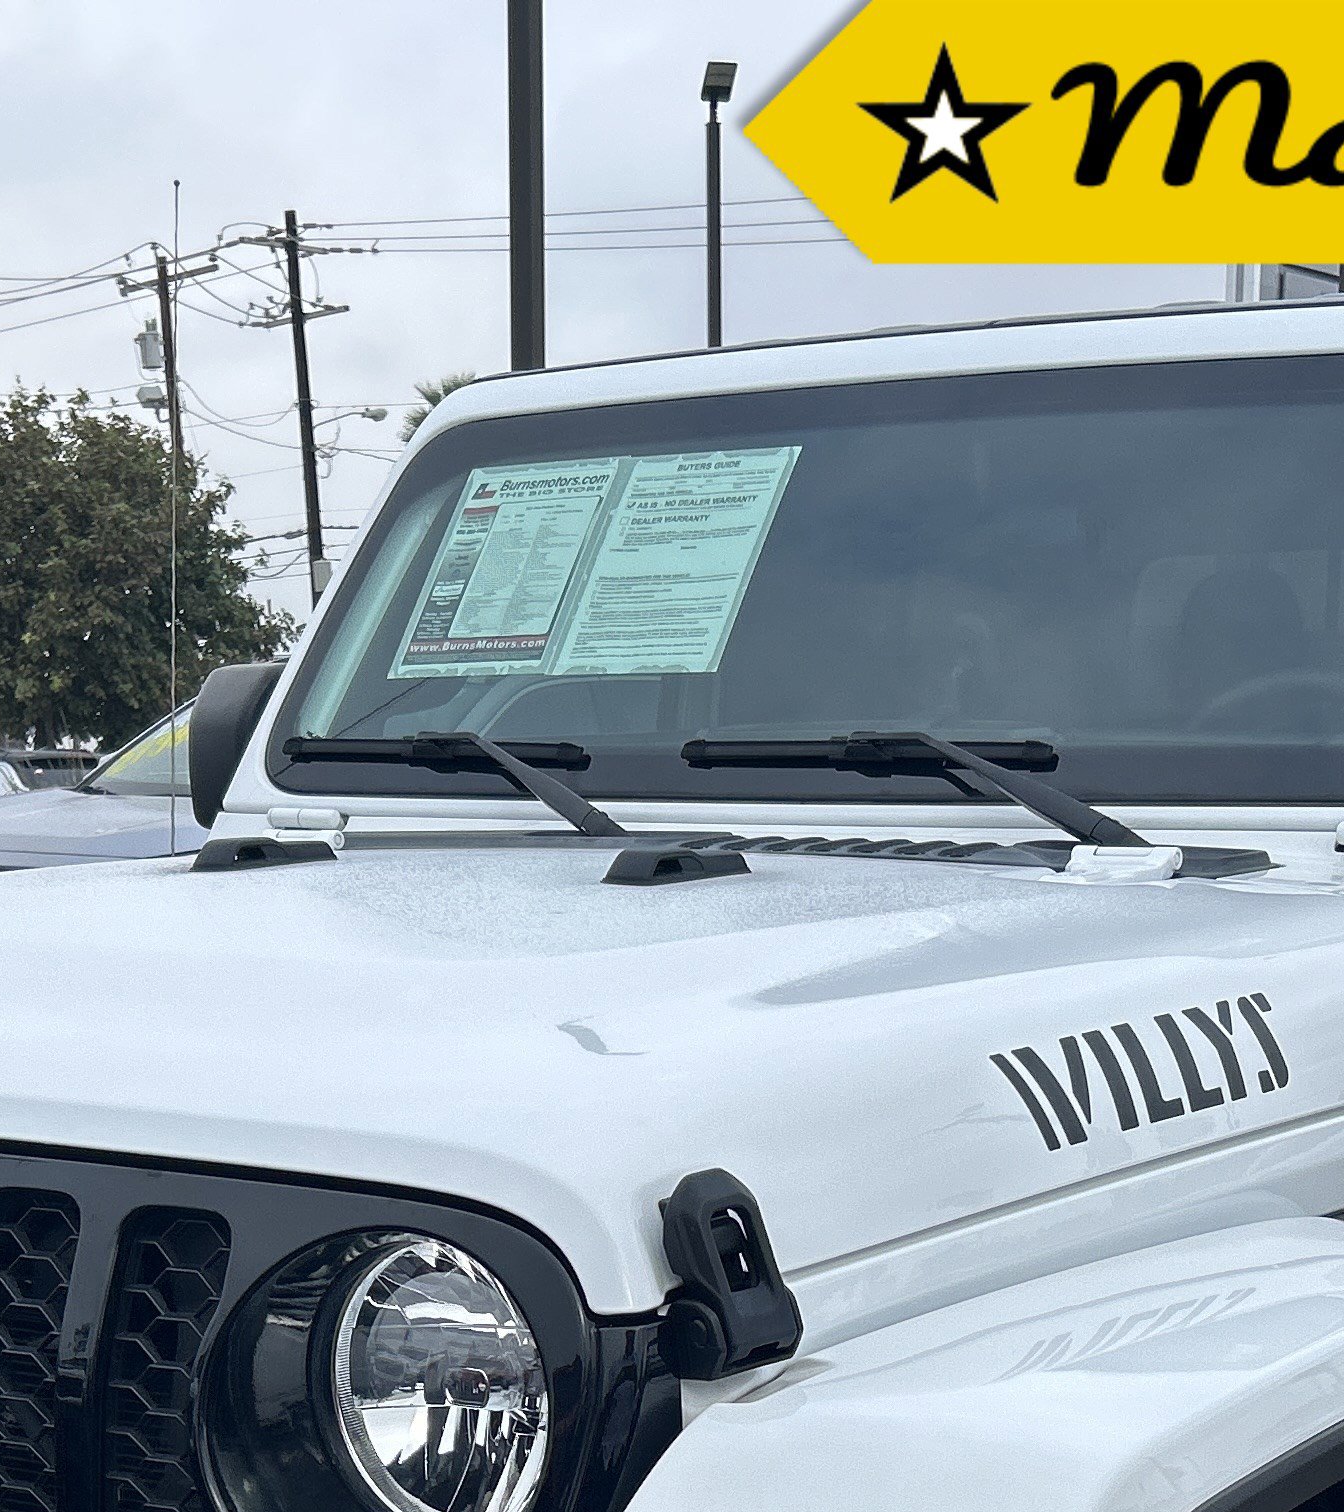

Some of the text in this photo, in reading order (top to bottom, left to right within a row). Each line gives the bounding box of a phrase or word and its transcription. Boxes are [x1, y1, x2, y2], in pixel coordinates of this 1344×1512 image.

[677, 460, 741, 472] BUYERS GUIDE
[500, 474, 610, 492] Burnsmotors.com
[557, 485, 604, 494] STORE
[664, 500, 677, 508] NO
[678, 498, 710, 507] DEALER
[712, 495, 758, 504] WARRANTY
[631, 514, 710, 525] DEALER WARRANTY
[409, 638, 546, 653] www.BurnsMotors.com
[989, 992, 1289, 1151] WILLYS
